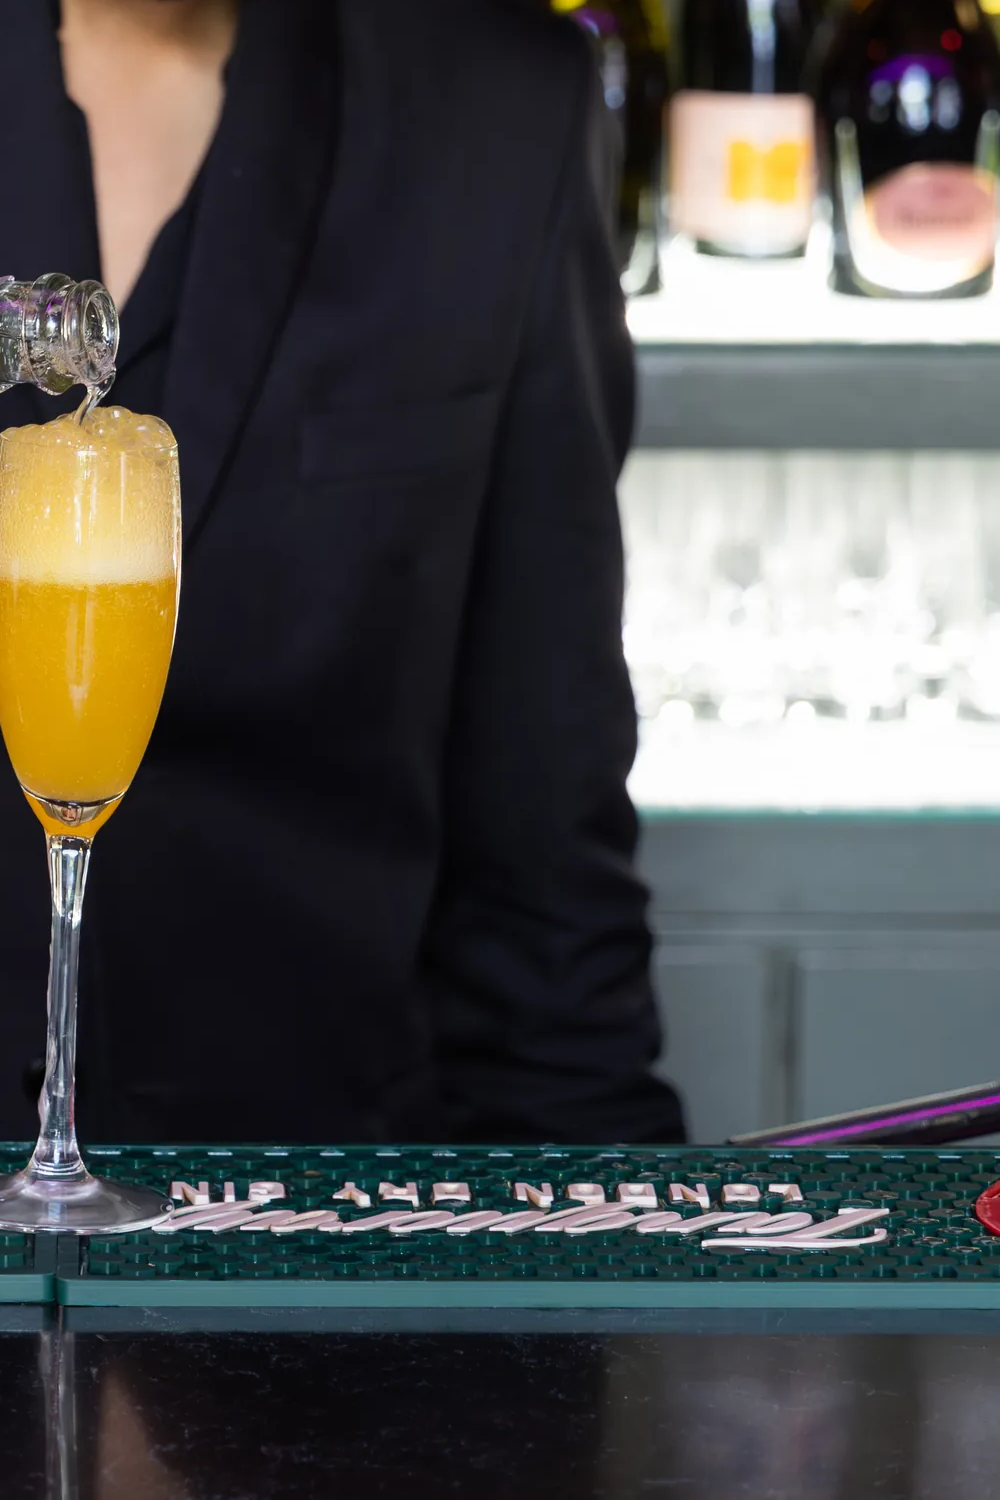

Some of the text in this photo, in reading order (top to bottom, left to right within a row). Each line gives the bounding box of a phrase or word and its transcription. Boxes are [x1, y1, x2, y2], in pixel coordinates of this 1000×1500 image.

[170, 1181, 804, 1209] LONDON DRY GIN
[152, 1198, 890, 1251] Tanqueray
